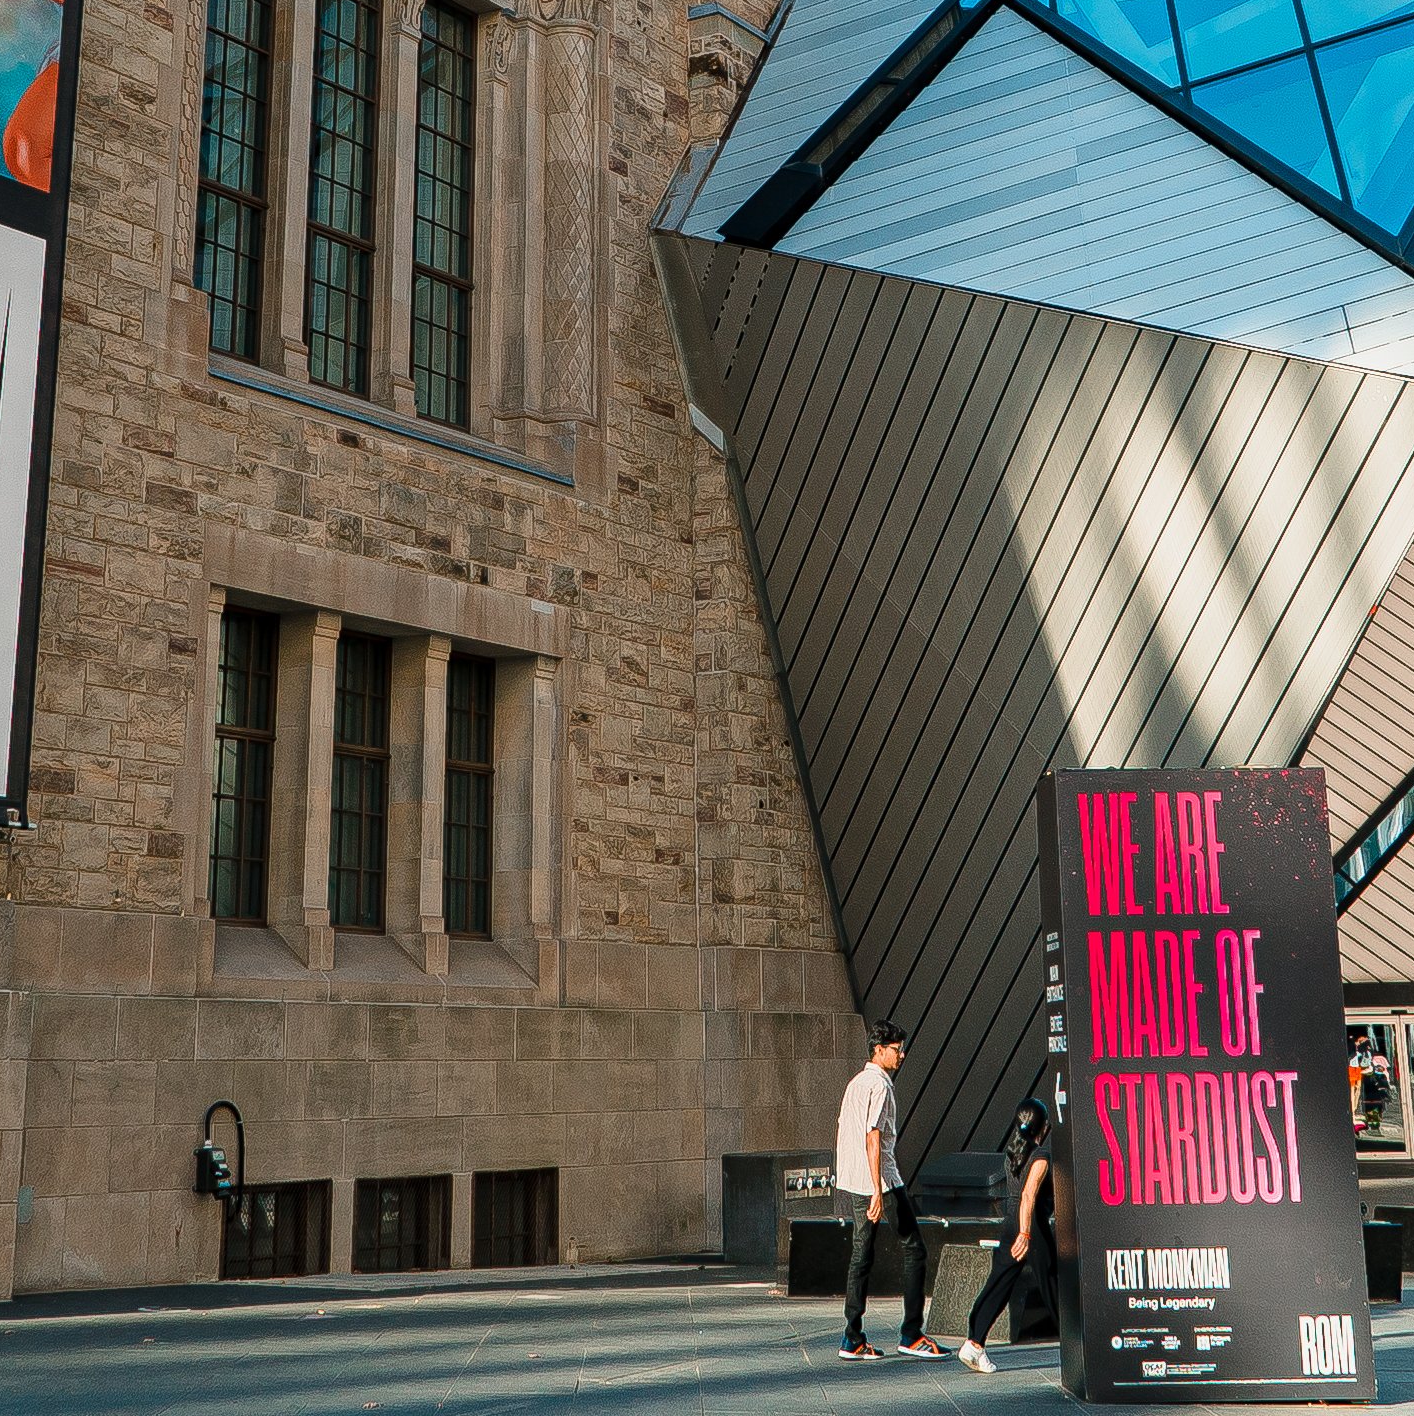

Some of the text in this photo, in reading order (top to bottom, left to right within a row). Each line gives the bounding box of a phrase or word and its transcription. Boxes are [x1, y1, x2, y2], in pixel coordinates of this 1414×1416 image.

[1077, 790, 1230, 916] WE ARE
[1088, 929, 1264, 1059] MADE OF
[1094, 1071, 1302, 1208] STARDUST
[1105, 1246, 1231, 1290] KENT MONKMAN
[1128, 1296, 1216, 1311] Being Legendary
[1298, 1313, 1357, 1376] ROM
